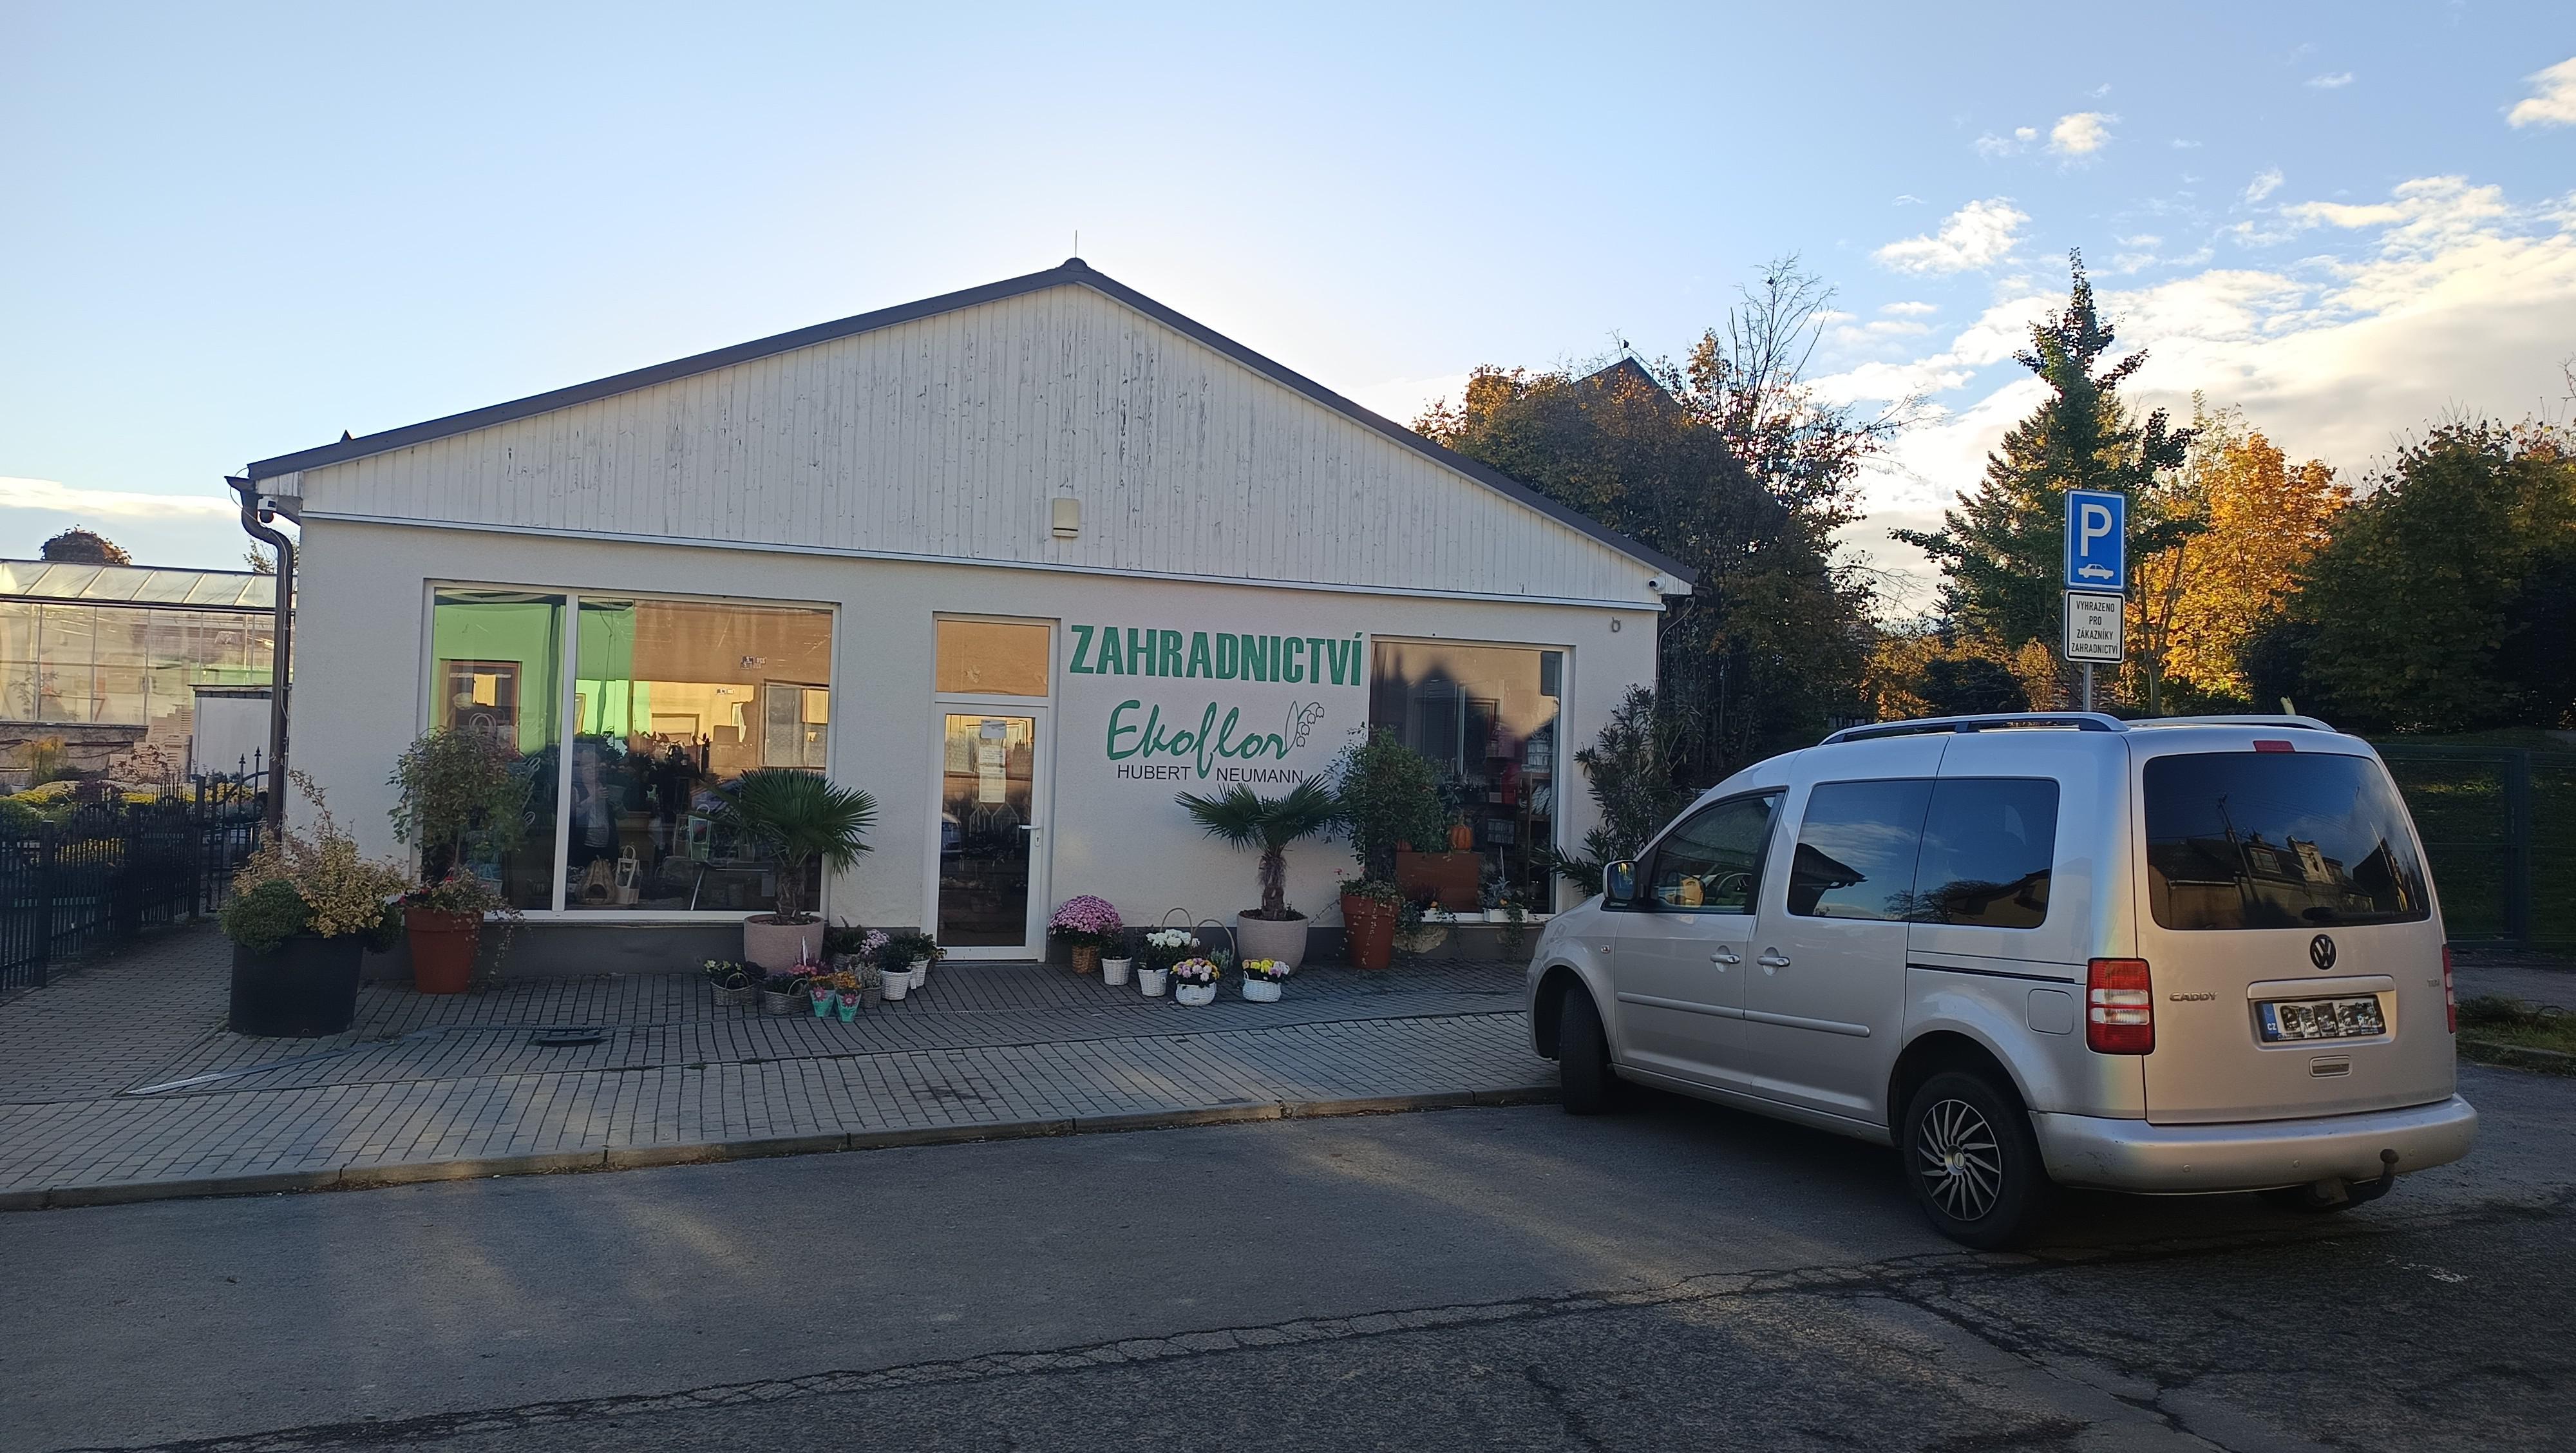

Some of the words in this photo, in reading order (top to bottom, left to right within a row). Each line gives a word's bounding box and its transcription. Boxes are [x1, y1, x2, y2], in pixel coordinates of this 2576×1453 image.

[2081, 504, 2112, 556] P
[2076, 600, 2115, 613] VYHRAZENO
[2088, 616, 2102, 625] PRO
[2077, 627, 2114, 640] ZÁKAZNÍKY
[1070, 625, 1363, 686] ZAHRADNICTVÍ
[2071, 643, 2119, 655] ZAHRADNICTVÍ
[1107, 699, 1288, 779] Ekoflor
[1117, 764, 1191, 780] HUBERT
[1217, 767, 1303, 784] NEUMANN
[2169, 992, 2217, 1002] CADDY
